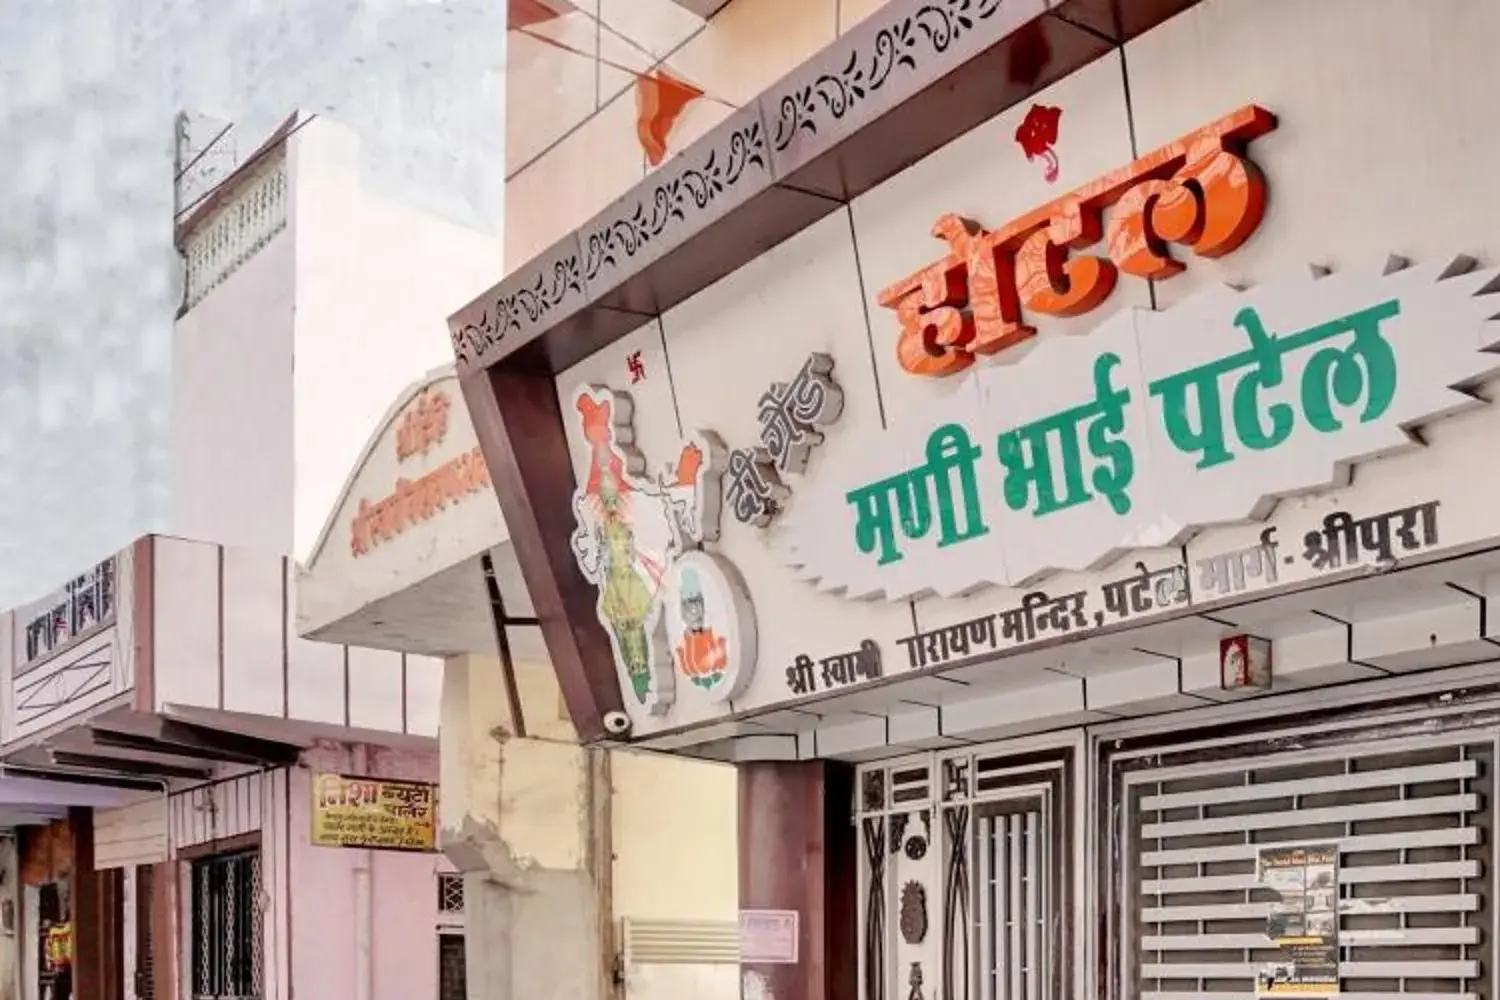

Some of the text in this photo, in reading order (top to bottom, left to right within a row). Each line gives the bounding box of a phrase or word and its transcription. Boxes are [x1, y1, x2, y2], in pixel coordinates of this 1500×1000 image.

[877, 104, 1278, 377] होटल
[846, 298, 1401, 565] मणी भाई पटेल
[785, 654, 816, 694] श्री
[1101, 562, 1189, 618] पटेल
